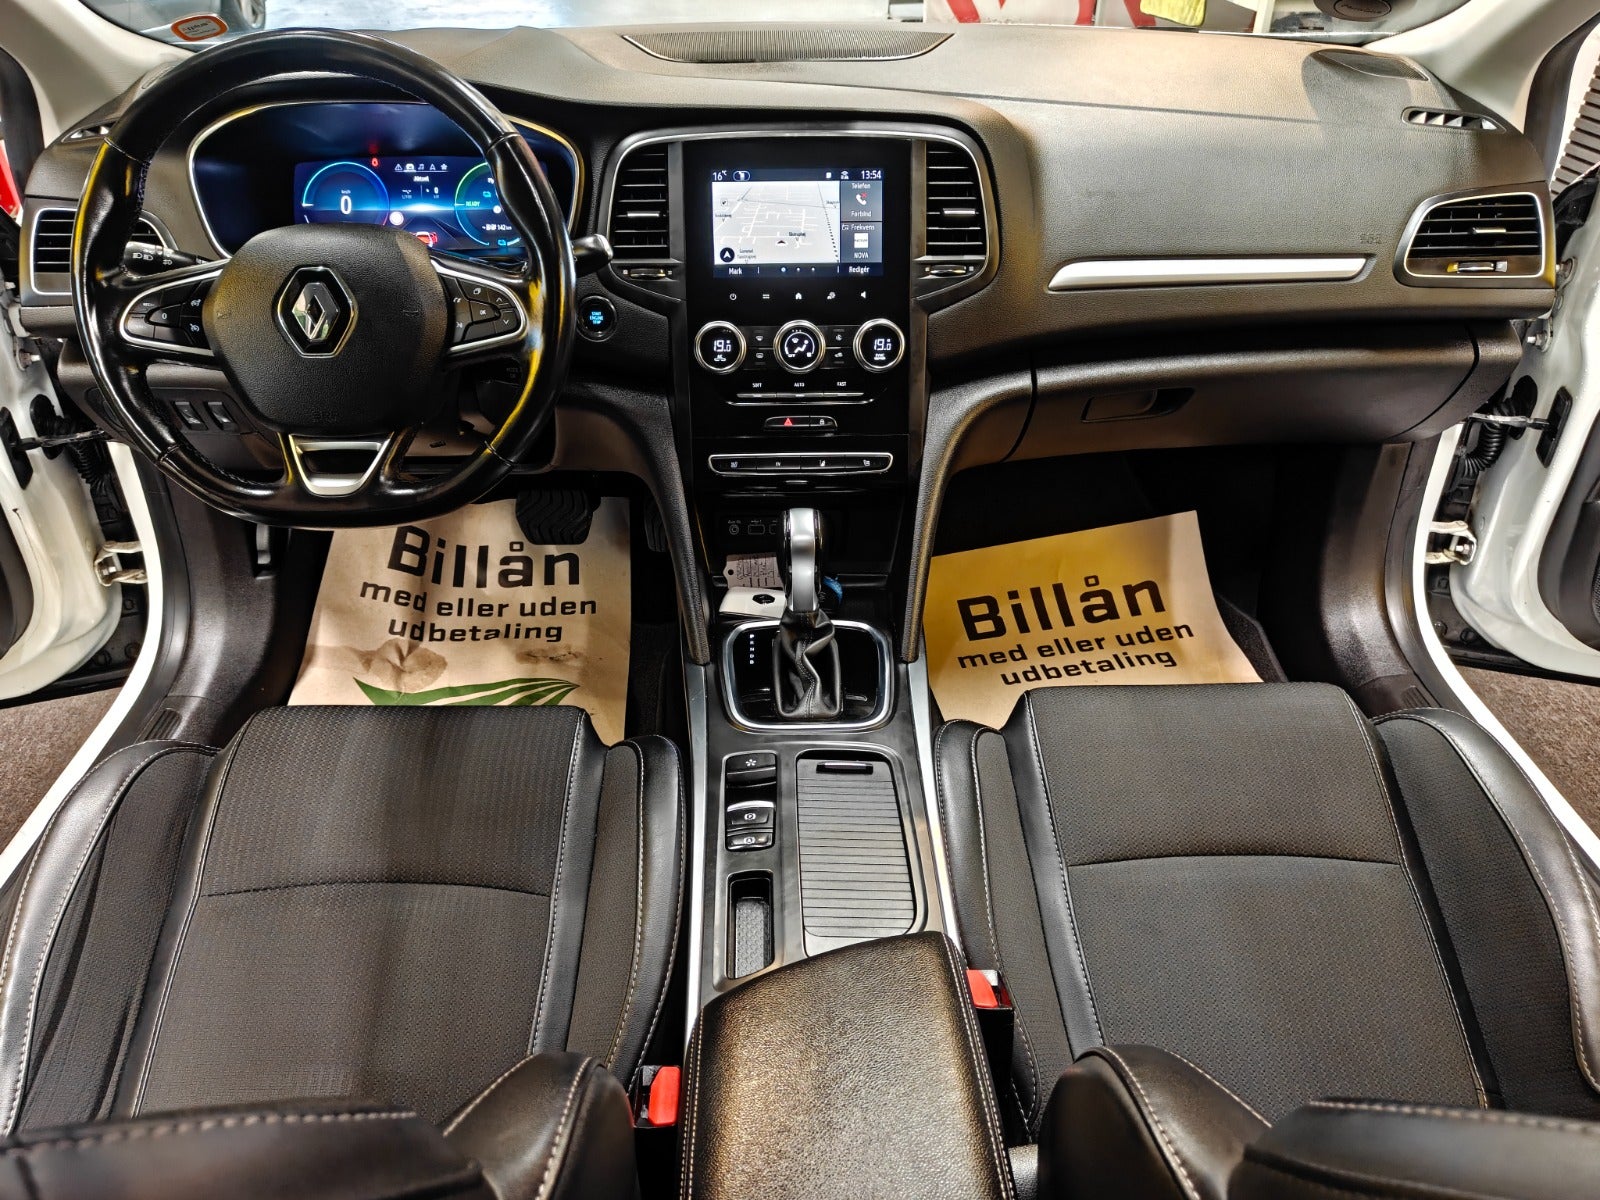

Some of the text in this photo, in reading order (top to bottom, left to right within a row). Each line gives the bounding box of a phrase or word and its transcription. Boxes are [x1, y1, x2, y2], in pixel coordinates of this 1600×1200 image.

[861, 170, 882, 180] 13:54
[340, 195, 352, 215] 0
[387, 524, 581, 589] Billån
[359, 581, 598, 618] med eller uden
[956, 574, 1167, 642] Billån
[387, 618, 564, 643] udbetaling
[957, 623, 1195, 669] med eller uden
[1000, 651, 1178, 686] udbetaling
